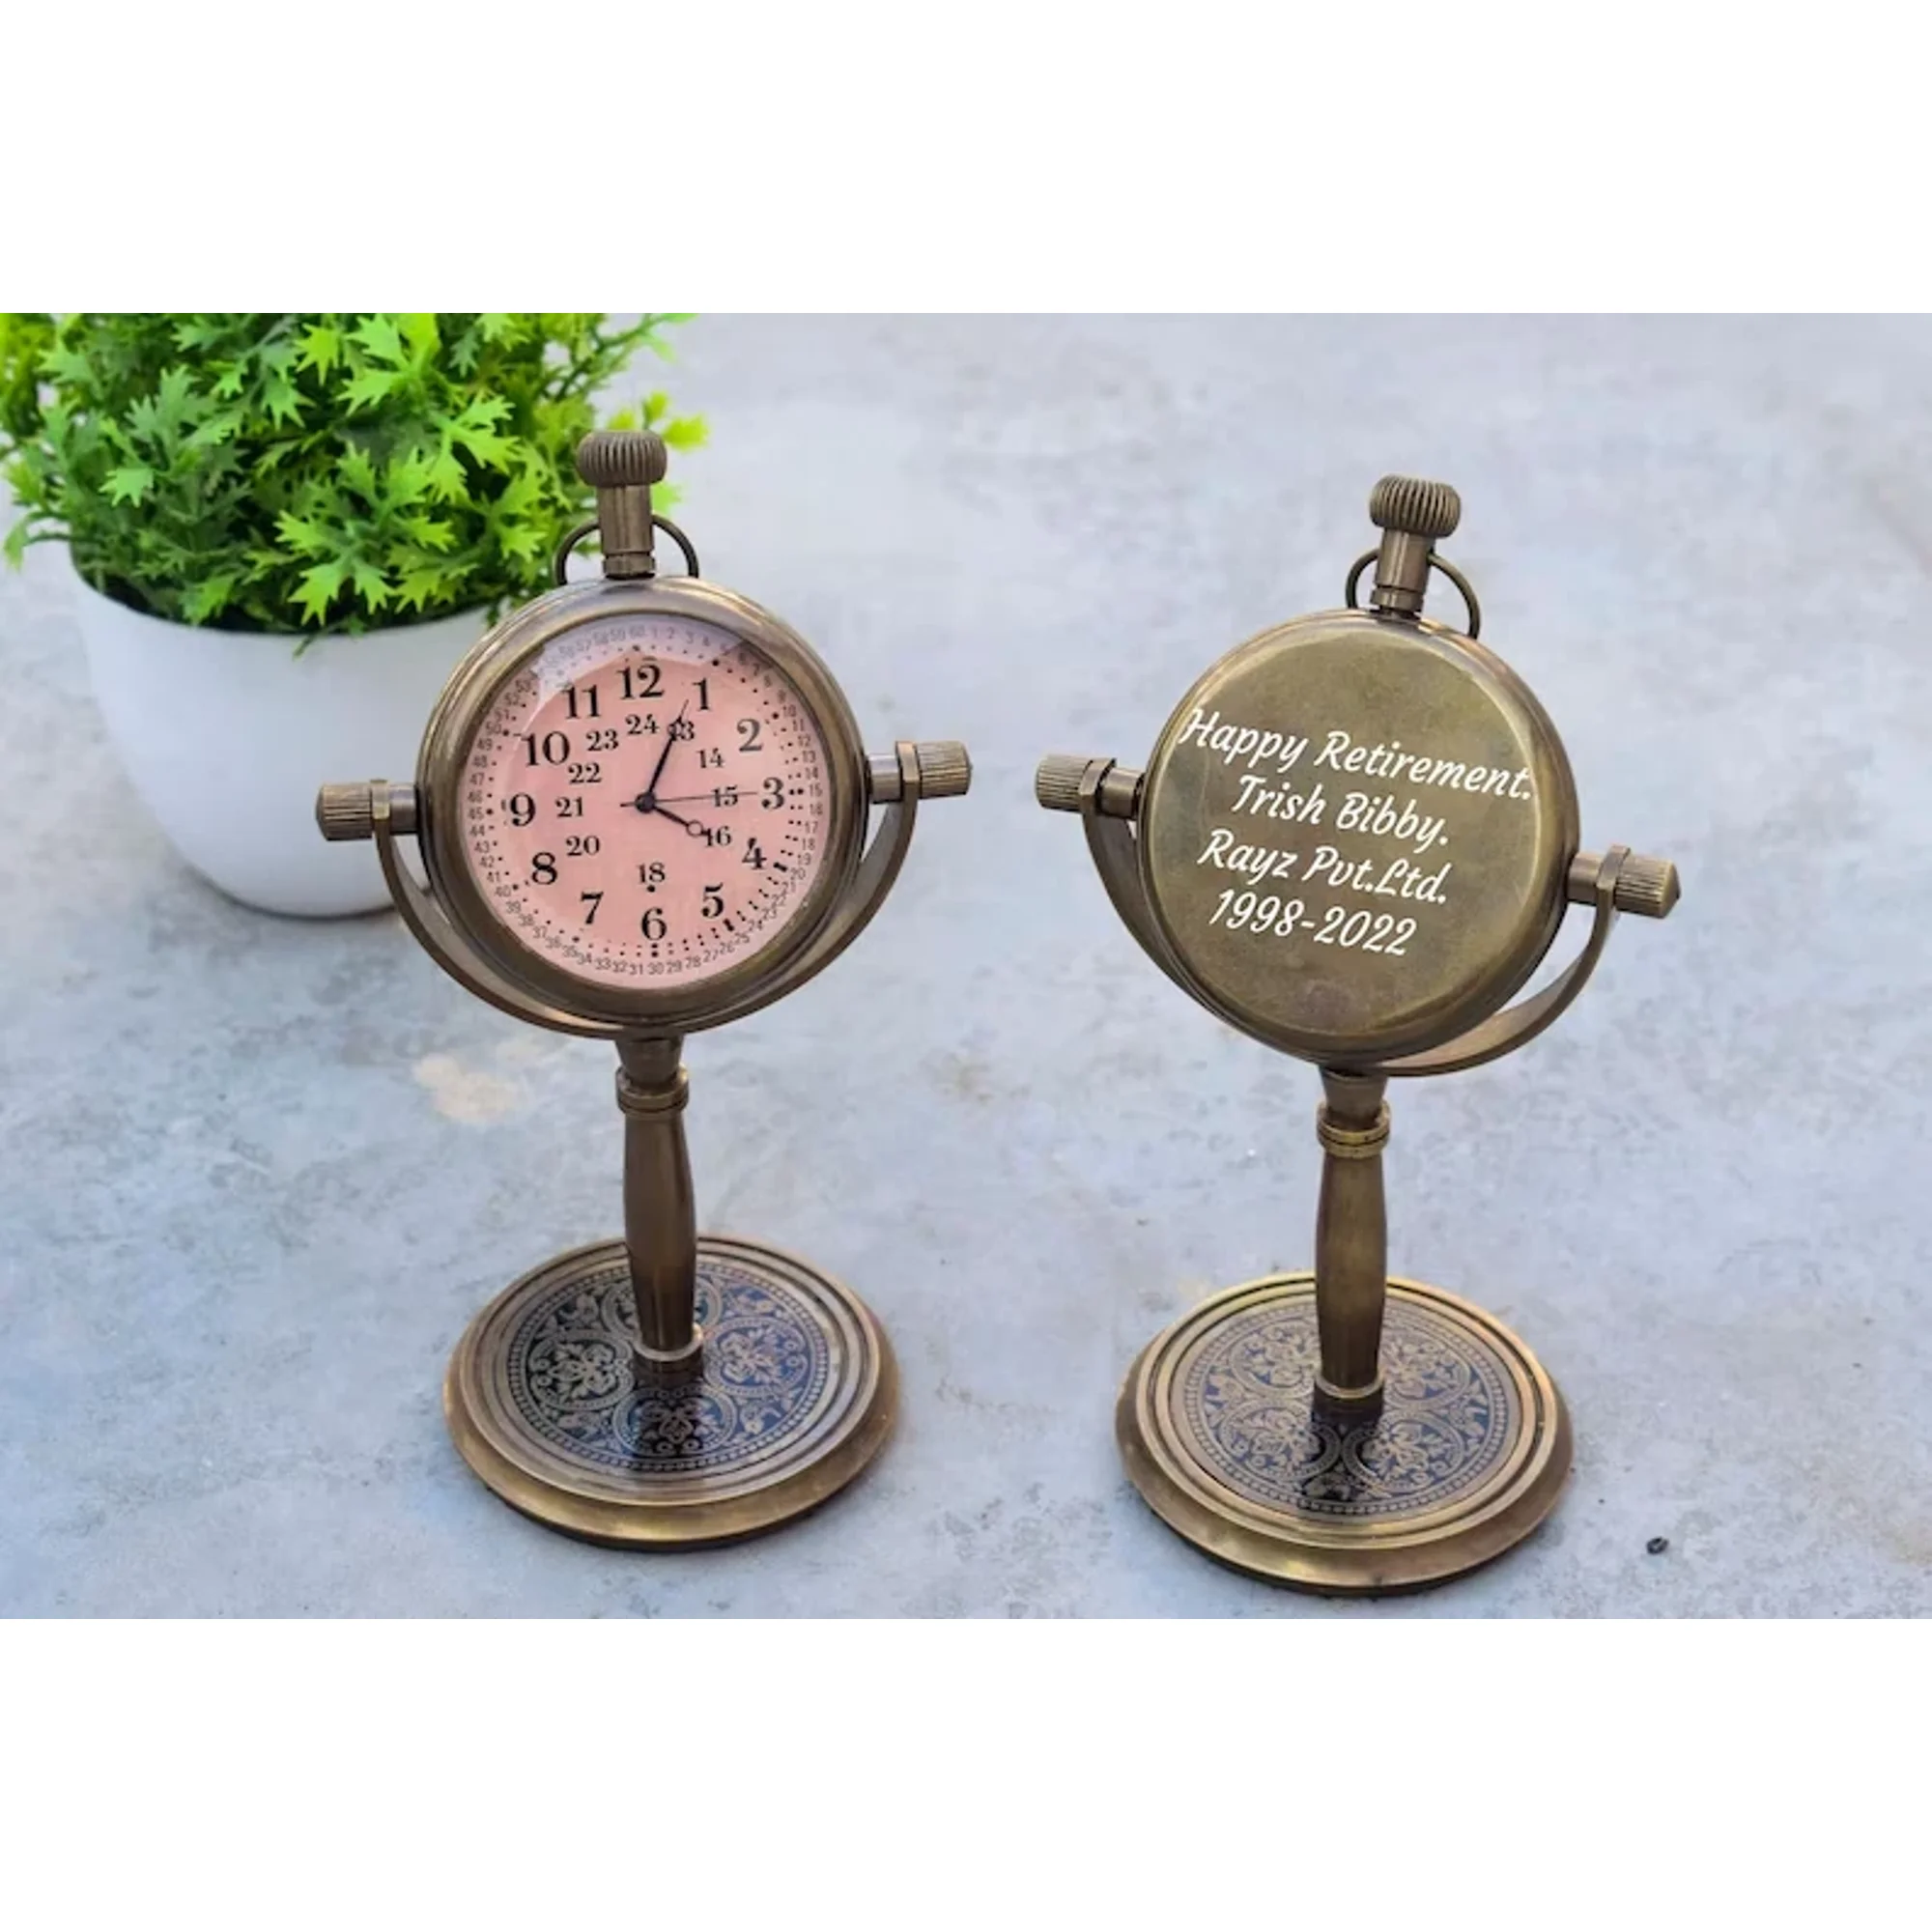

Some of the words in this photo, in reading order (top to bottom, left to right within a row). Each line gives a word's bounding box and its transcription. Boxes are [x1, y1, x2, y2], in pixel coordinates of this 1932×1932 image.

[616, 664, 665, 700] 12
[561, 683, 601, 720] 11
[692, 677, 710, 711] 1
[625, 713, 660, 736] 24
[736, 718, 763, 753] 2
[522, 730, 571, 766] 10
[586, 729, 619, 752] 23
[798, 734, 810, 747] 12
[696, 748, 724, 768] 14
[802, 750, 816, 763] 13
[1179, 708, 1309, 774] Happy
[1314, 730, 1533, 800] Retirement.
[471, 772, 485, 785] 47
[568, 762, 602, 783] 22
[712, 785, 738, 808] 15
[761, 777, 785, 810] 3
[810, 783, 822, 796] 15
[510, 792, 536, 827] 9
[555, 796, 584, 817] 21
[1231, 775, 1325, 825] Trish
[1335, 791, 1449, 854] Bibby.
[470, 824, 485, 837] 44
[703, 825, 731, 847] 16
[474, 841, 490, 853] 43
[566, 835, 600, 856] 20
[742, 838, 767, 869] 4
[487, 871, 500, 882] 41
[531, 852, 557, 885] 8
[638, 862, 666, 883] 18
[1198, 829, 1299, 886] Rayz
[1301, 846, 1453, 903] Pvt.Ltd.
[581, 891, 604, 924] 7
[702, 883, 724, 919] 5
[641, 907, 668, 941] 6
[1208, 889, 1417, 956] 1998-2022
[630, 964, 643, 976] 31
[647, 962, 664, 975] 30
